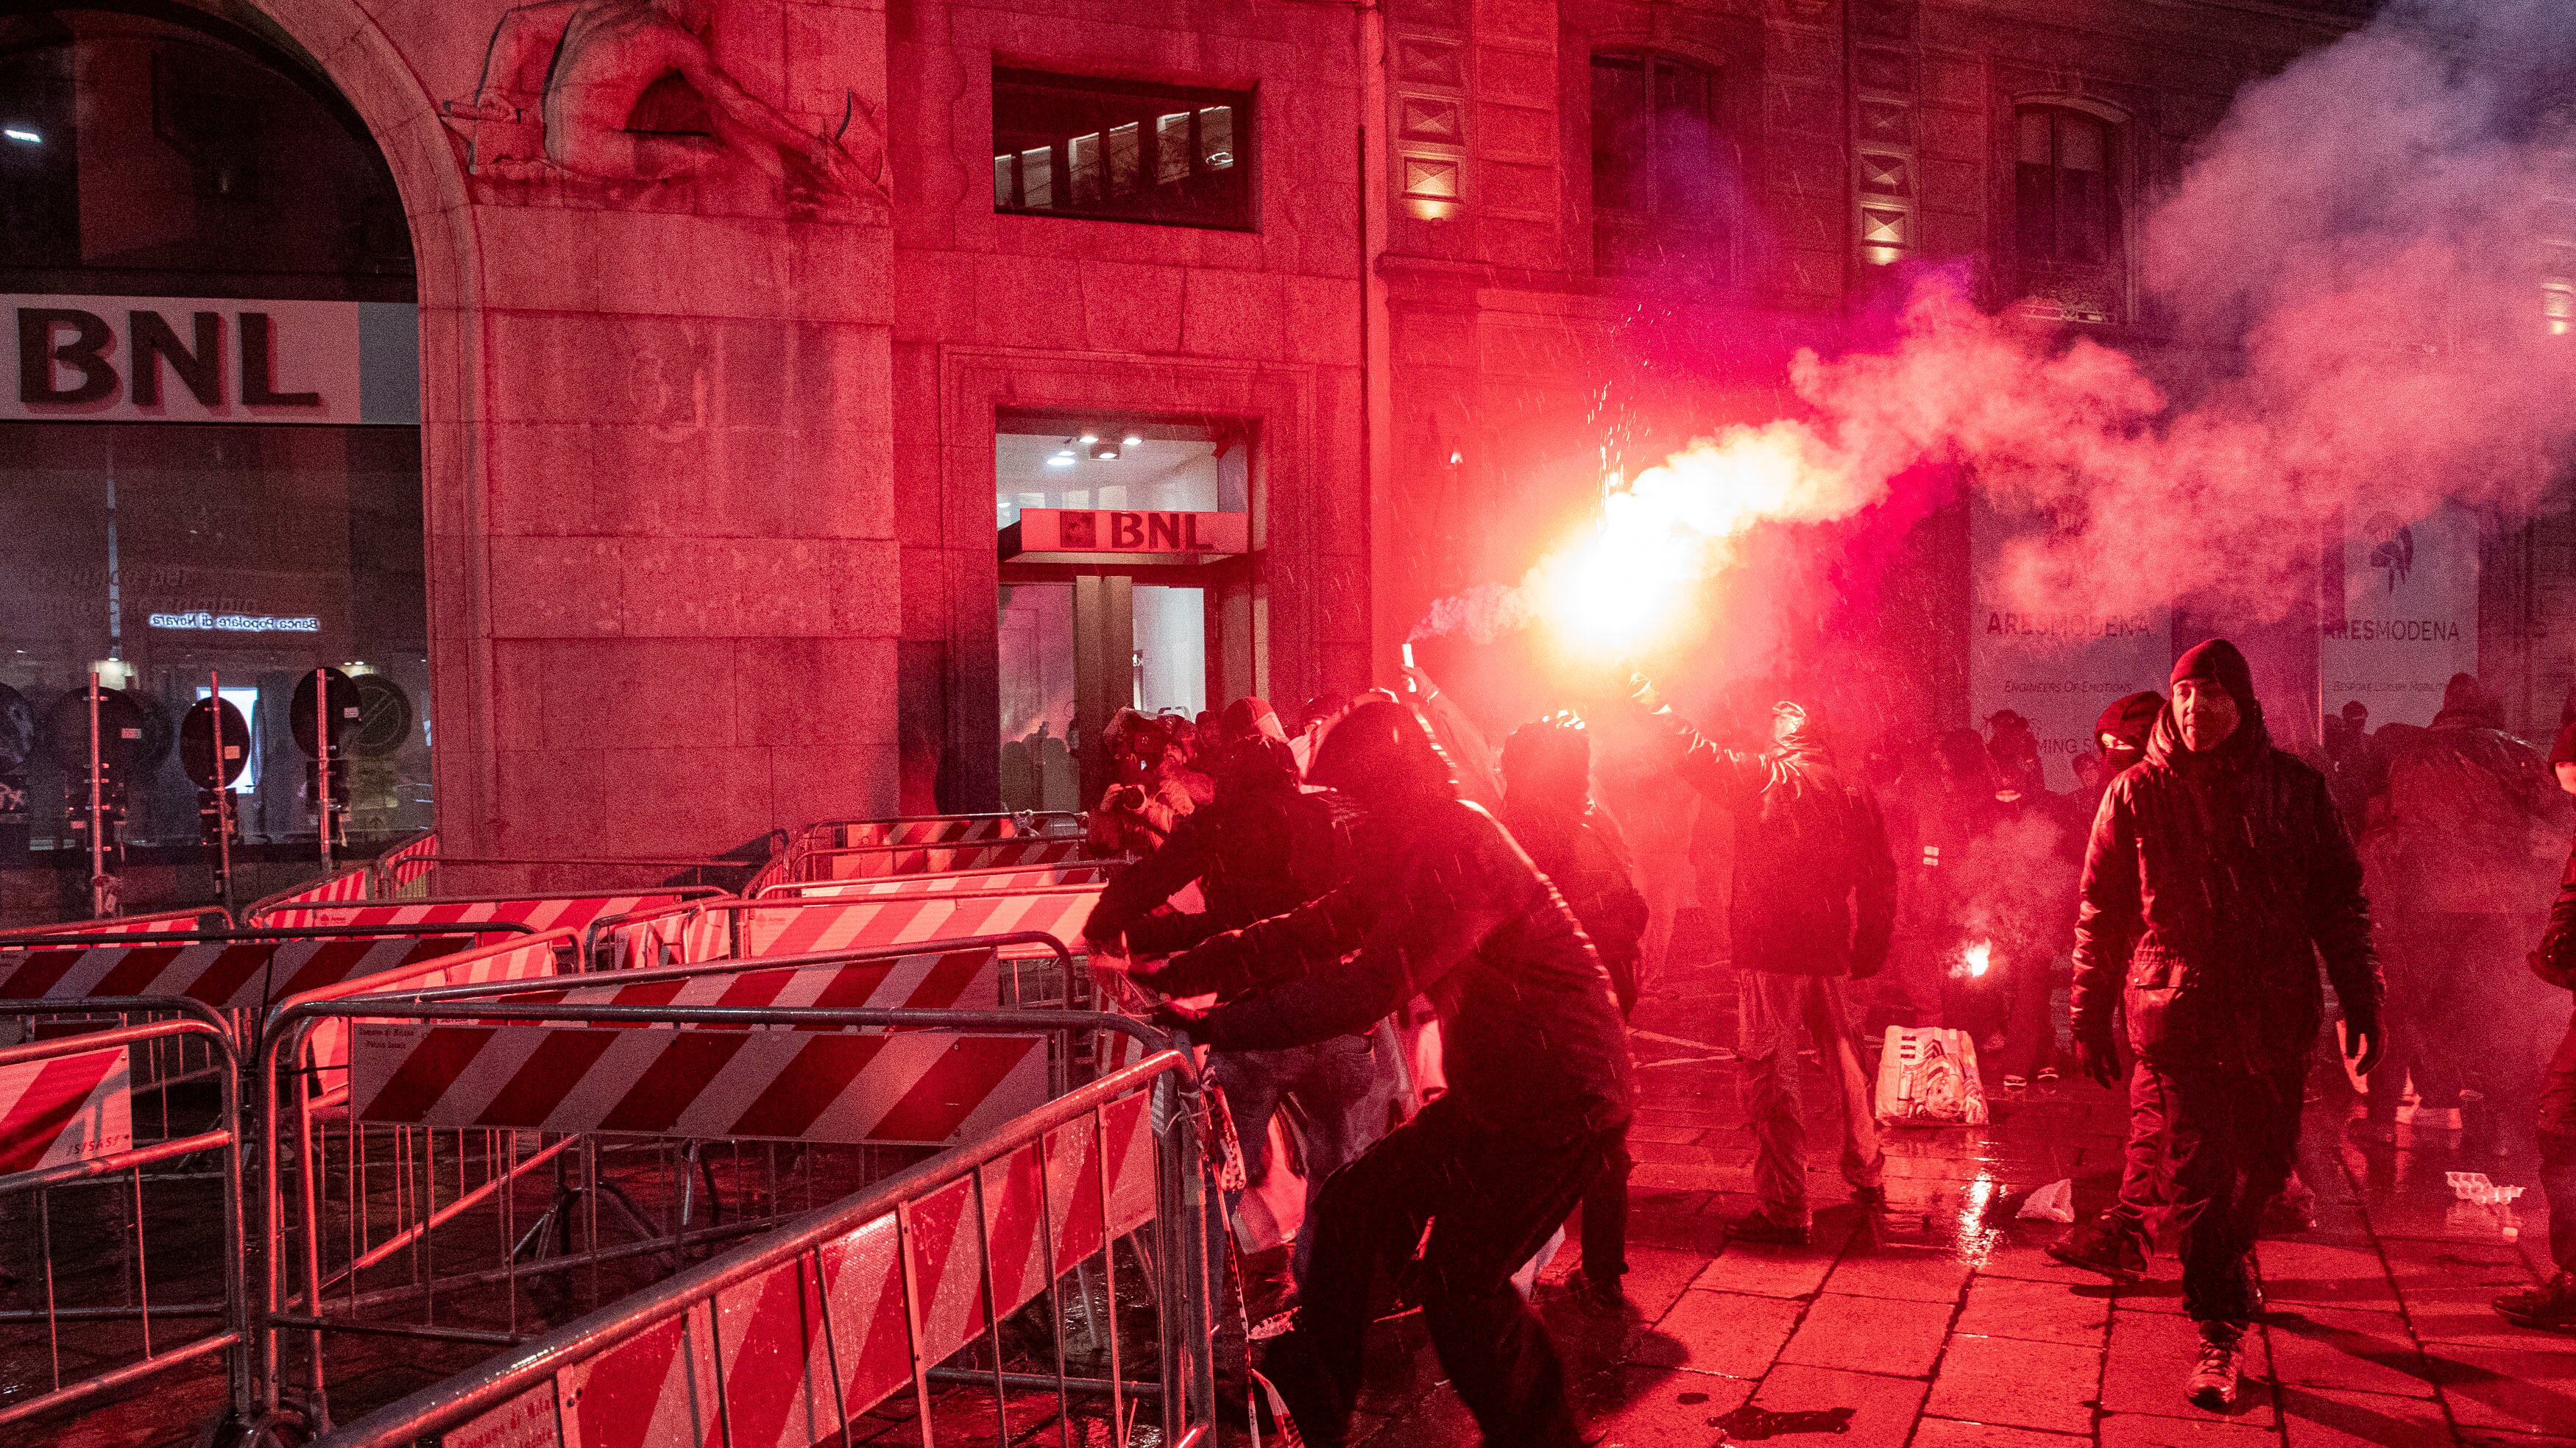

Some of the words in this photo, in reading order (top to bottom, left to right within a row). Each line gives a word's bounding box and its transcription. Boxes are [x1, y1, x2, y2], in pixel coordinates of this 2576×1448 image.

[17, 308, 324, 412] BNL
[1111, 512, 1214, 550] BNL
[2037, 739, 2078, 754] MING
[526, 1398, 553, 1419] Mila
